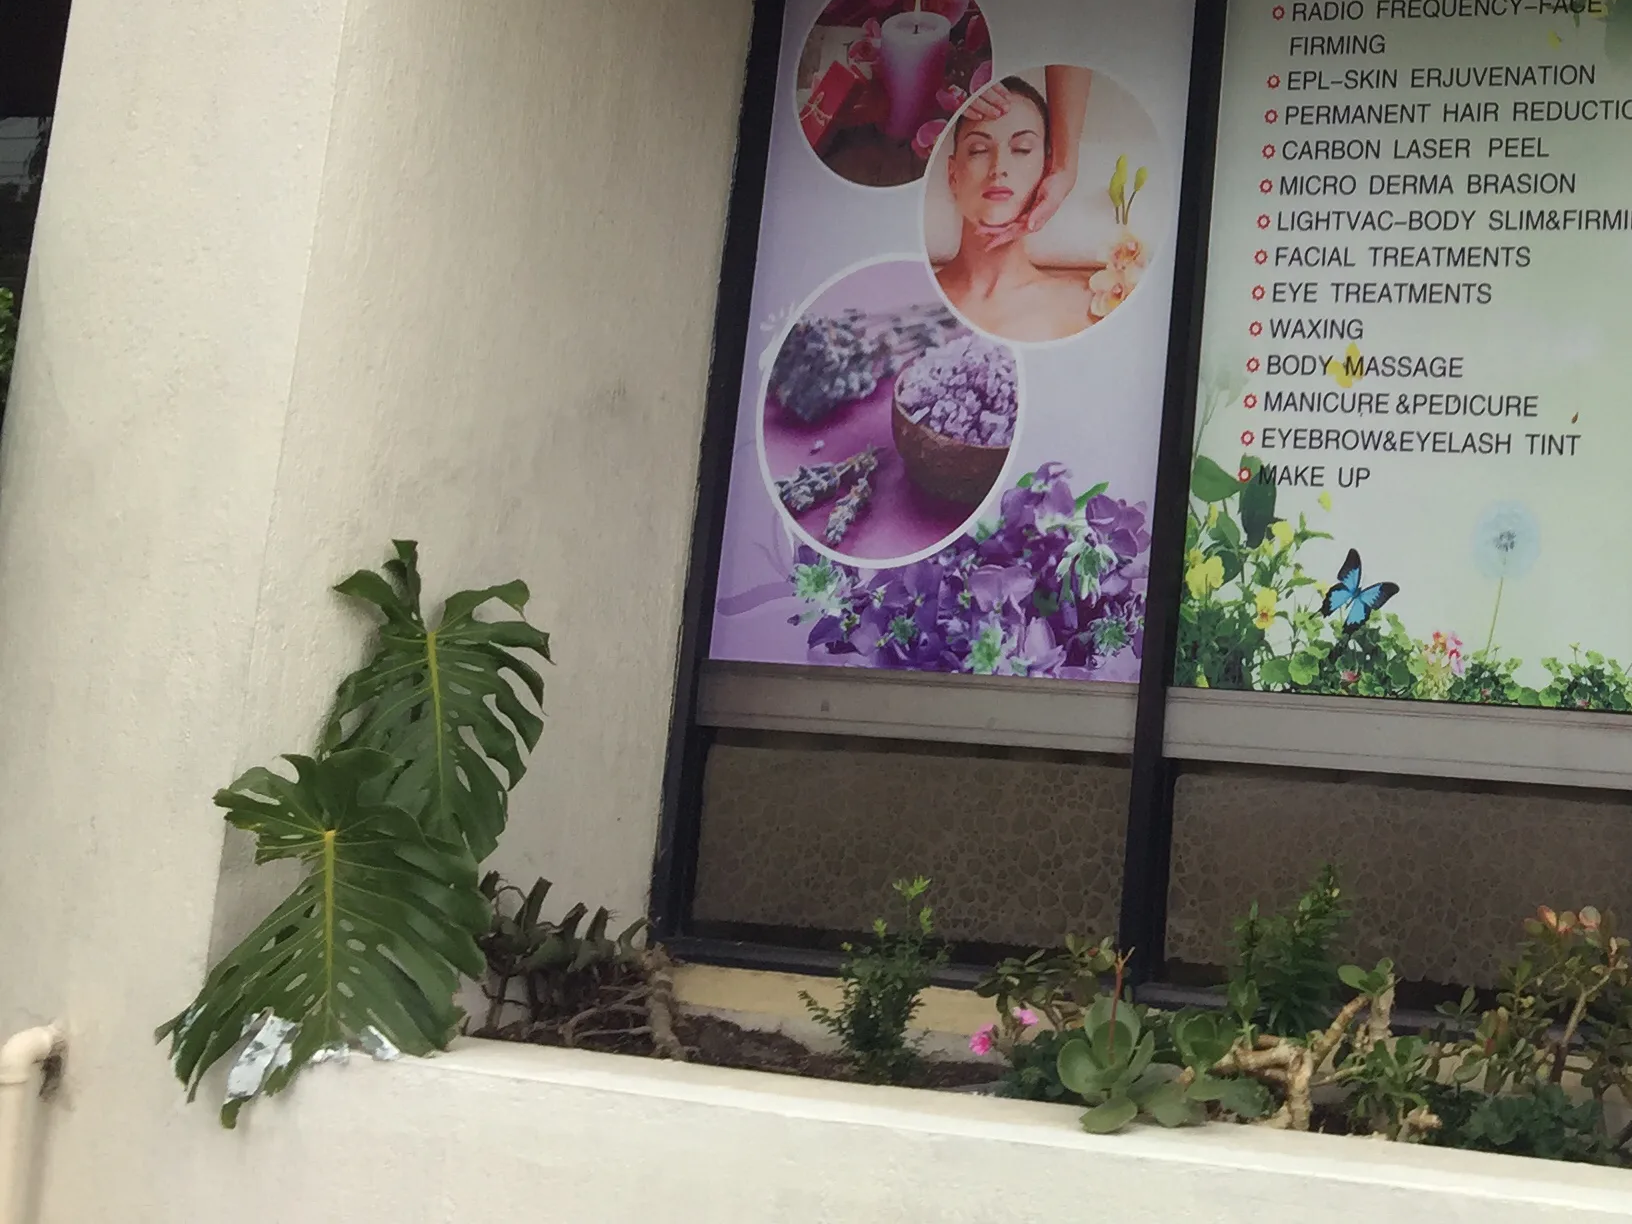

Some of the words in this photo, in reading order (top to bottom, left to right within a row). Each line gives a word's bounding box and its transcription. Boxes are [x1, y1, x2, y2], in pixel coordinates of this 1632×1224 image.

[1292, 0, 1364, 22] RADIO
[1290, 34, 1386, 56] FIRMING
[1287, 69, 1398, 91] EPL-SKIN
[1410, 64, 1595, 88] ERJUVENATION
[1284, 103, 1431, 125] PERMANENT
[1443, 102, 1499, 123] HAIR
[1282, 139, 1380, 160] CARBON
[1393, 138, 1471, 159] LASER
[1488, 138, 1550, 158] PEEL
[1279, 175, 1356, 195] MICRO
[1369, 174, 1454, 195] DERMA
[1467, 173, 1576, 194] BRASION
[1277, 210, 1477, 232] LIGHTVAC-BODY
[1275, 247, 1356, 267] FACIAL
[1368, 246, 1531, 267] TREATMENTS
[1272, 283, 1317, 304] EYE
[1331, 283, 1492, 304] TREATMENTS
[1269, 318, 1364, 340] WAXING
[1267, 355, 1334, 376] BODY
[1345, 356, 1464, 378] MASSAGE
[1261, 428, 1512, 454] EYEBROW&EYELASH
[1525, 434, 1581, 456] TINT
[1259, 466, 1325, 487] MAKE
[1338, 467, 1371, 488] UP
